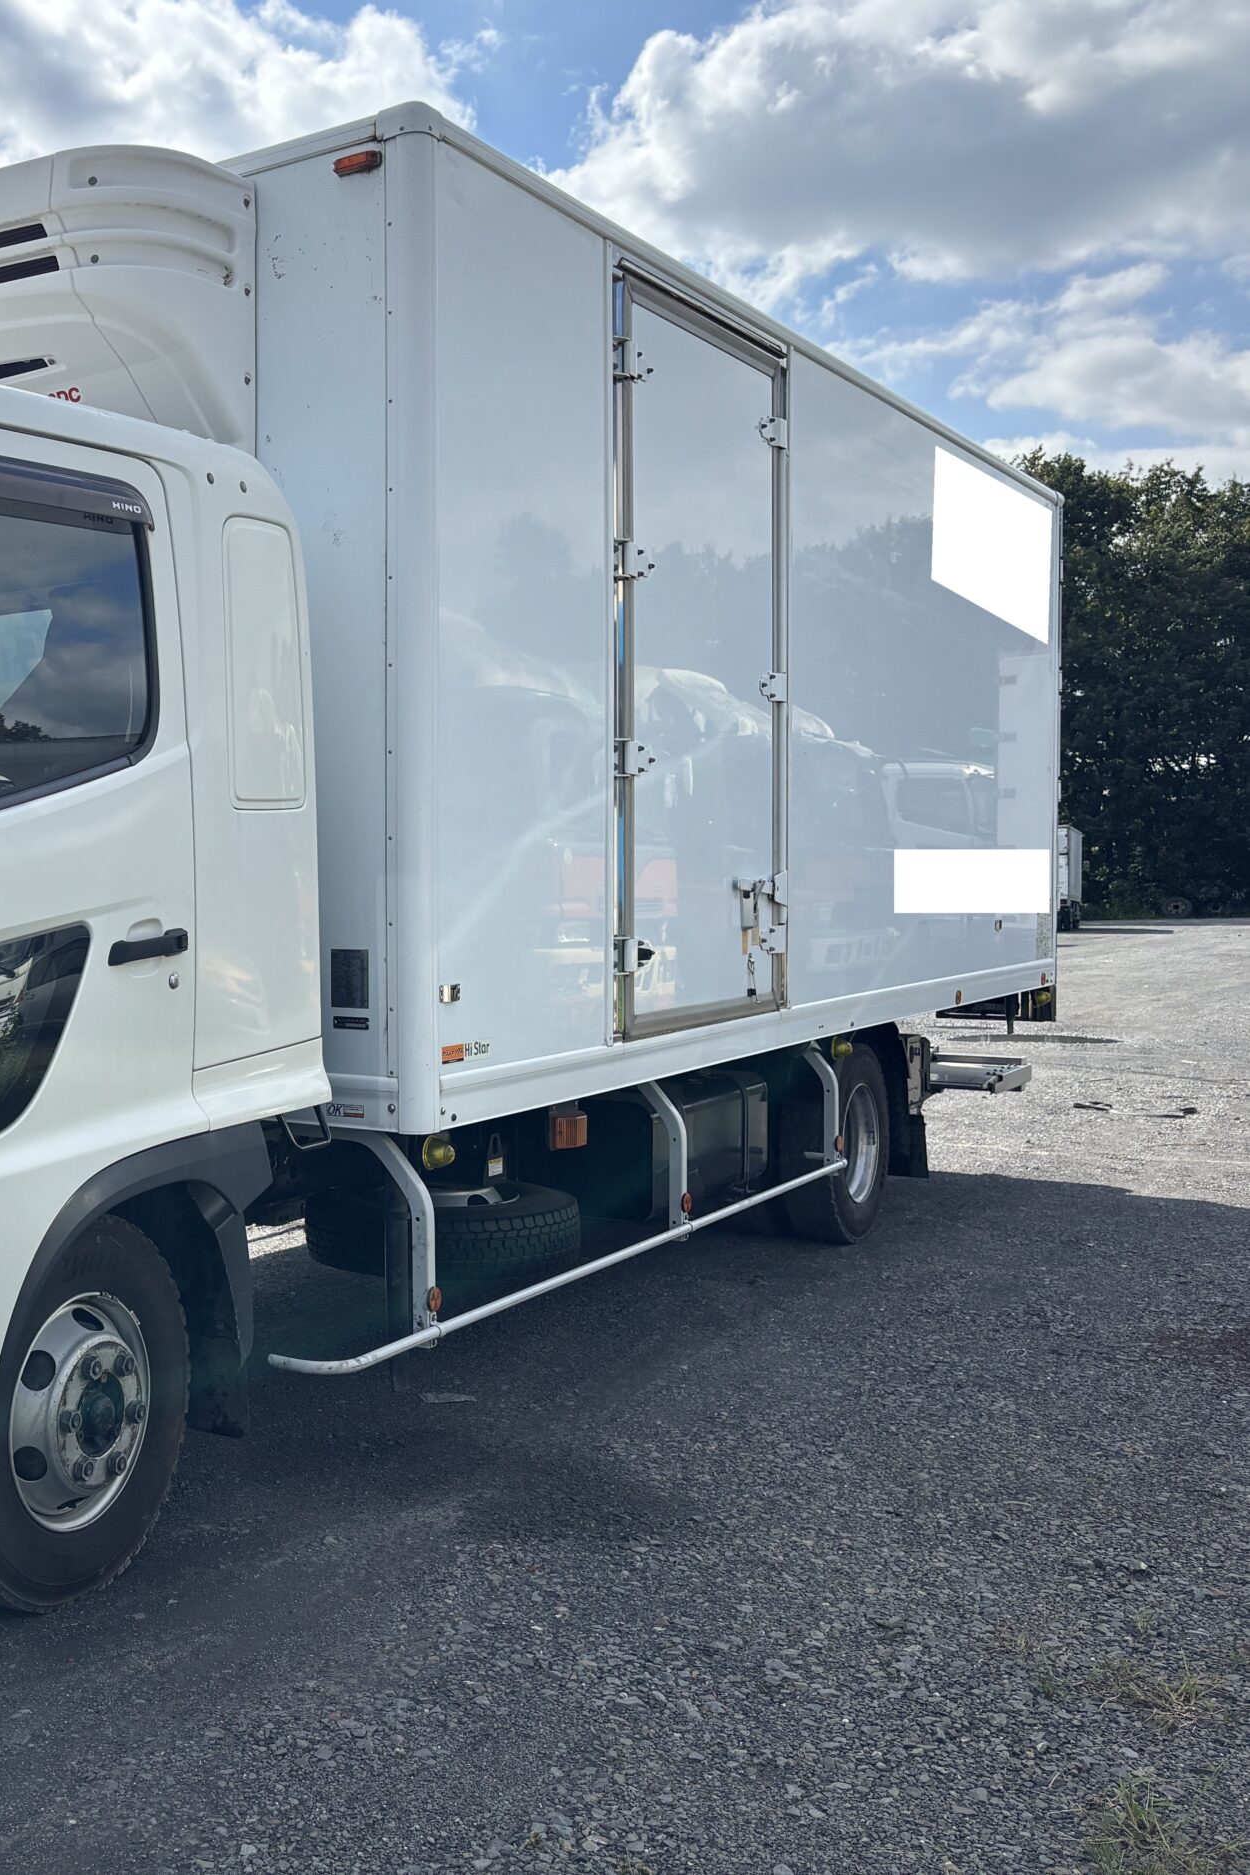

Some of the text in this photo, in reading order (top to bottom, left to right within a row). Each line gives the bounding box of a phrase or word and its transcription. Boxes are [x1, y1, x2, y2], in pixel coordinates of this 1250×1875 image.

[48, 387, 81, 403] DC
[112, 501, 142, 514] HINO
[83, 511, 114, 525] HINO
[464, 1041, 490, 1057] Hi Star
